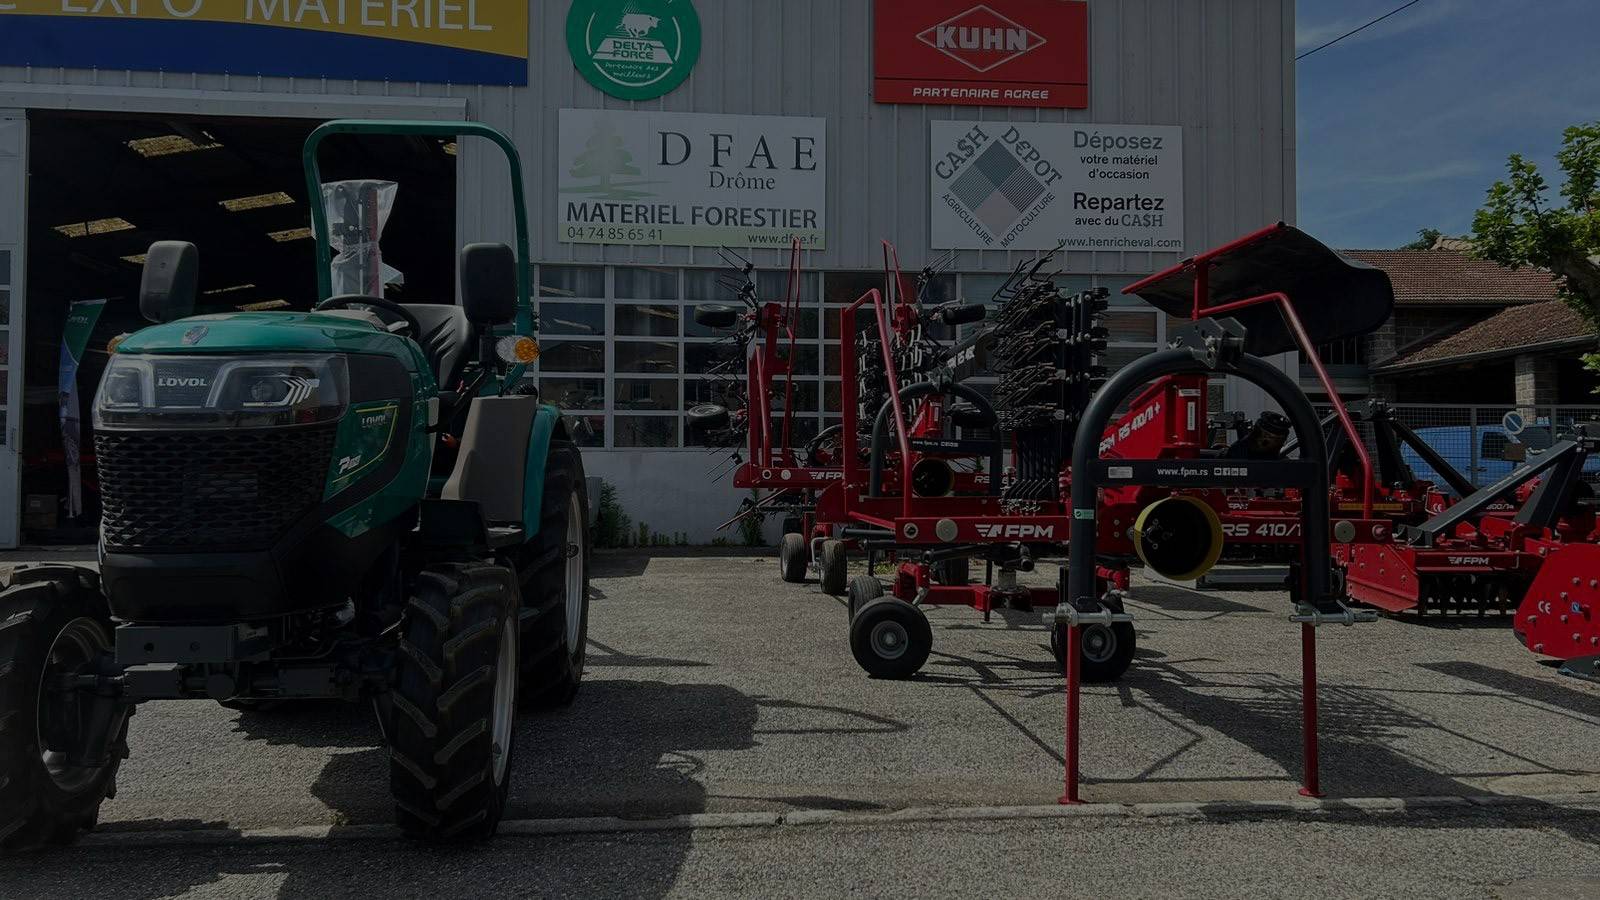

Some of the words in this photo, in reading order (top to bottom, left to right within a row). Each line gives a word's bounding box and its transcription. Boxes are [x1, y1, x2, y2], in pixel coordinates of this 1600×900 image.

[936, 26, 1027, 50] KUHN
[613, 40, 654, 51] DELTA
[613, 50, 654, 60] FORCE
[912, 87, 999, 98] PARTENAIRE
[1003, 89, 1049, 99] AGREE
[1074, 131, 1163, 152] Déposez
[1080, 154, 1109, 165] votre
[1112, 155, 1158, 165] matériel
[1088, 168, 1149, 179] d'occasion
[709, 171, 776, 190] Drôme
[1073, 192, 1164, 213] Repartez
[567, 202, 684, 225] MATERIEL
[691, 206, 817, 229] FORESTIER
[942, 193, 994, 246] AGRICULTURE
[1000, 192, 1055, 248] MOTOCULTURE
[1075, 217, 1101, 226] avec
[1104, 216, 1119, 226] du
[567, 226, 584, 239] 04
[588, 227, 604, 239] 74
[608, 227, 624, 240] 85
[628, 229, 644, 241] 65
[648, 229, 663, 241] 41
[748, 232, 819, 245] www.dfe.fr
[1057, 236, 1182, 248] www.henricheval.com
[157, 377, 209, 388] LOVOL
[1156, 466, 1209, 478] www.fpm.rs
[1005, 524, 1054, 539] FPM
[1221, 523, 1251, 537] RS
[1463, 556, 1490, 565] FPM
